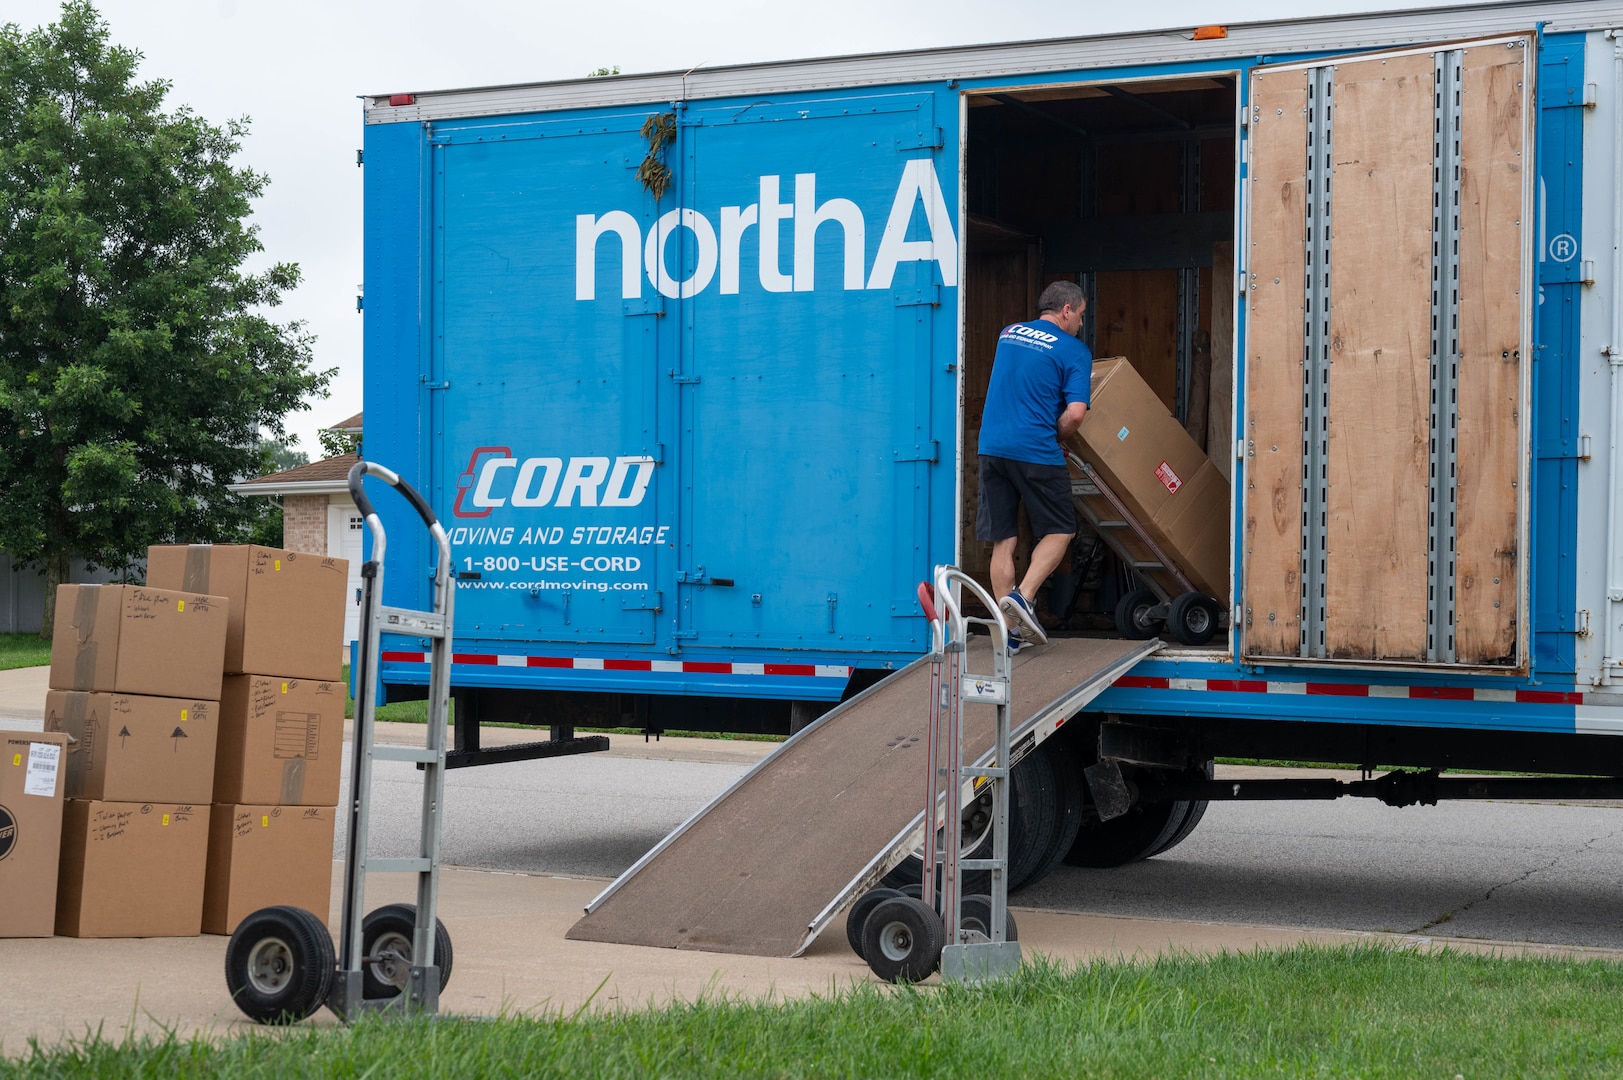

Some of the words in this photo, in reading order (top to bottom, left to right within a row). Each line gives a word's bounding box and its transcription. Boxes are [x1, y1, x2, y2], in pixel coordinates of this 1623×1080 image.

[1008, 325, 1058, 343] CORD
[471, 455, 655, 507] CORD
[519, 527, 564, 545] AND
[570, 526, 670, 545] STORAGE
[463, 556, 641, 572] 1-800-USE-CORD
[456, 579, 649, 593] www.cordmoving.com
